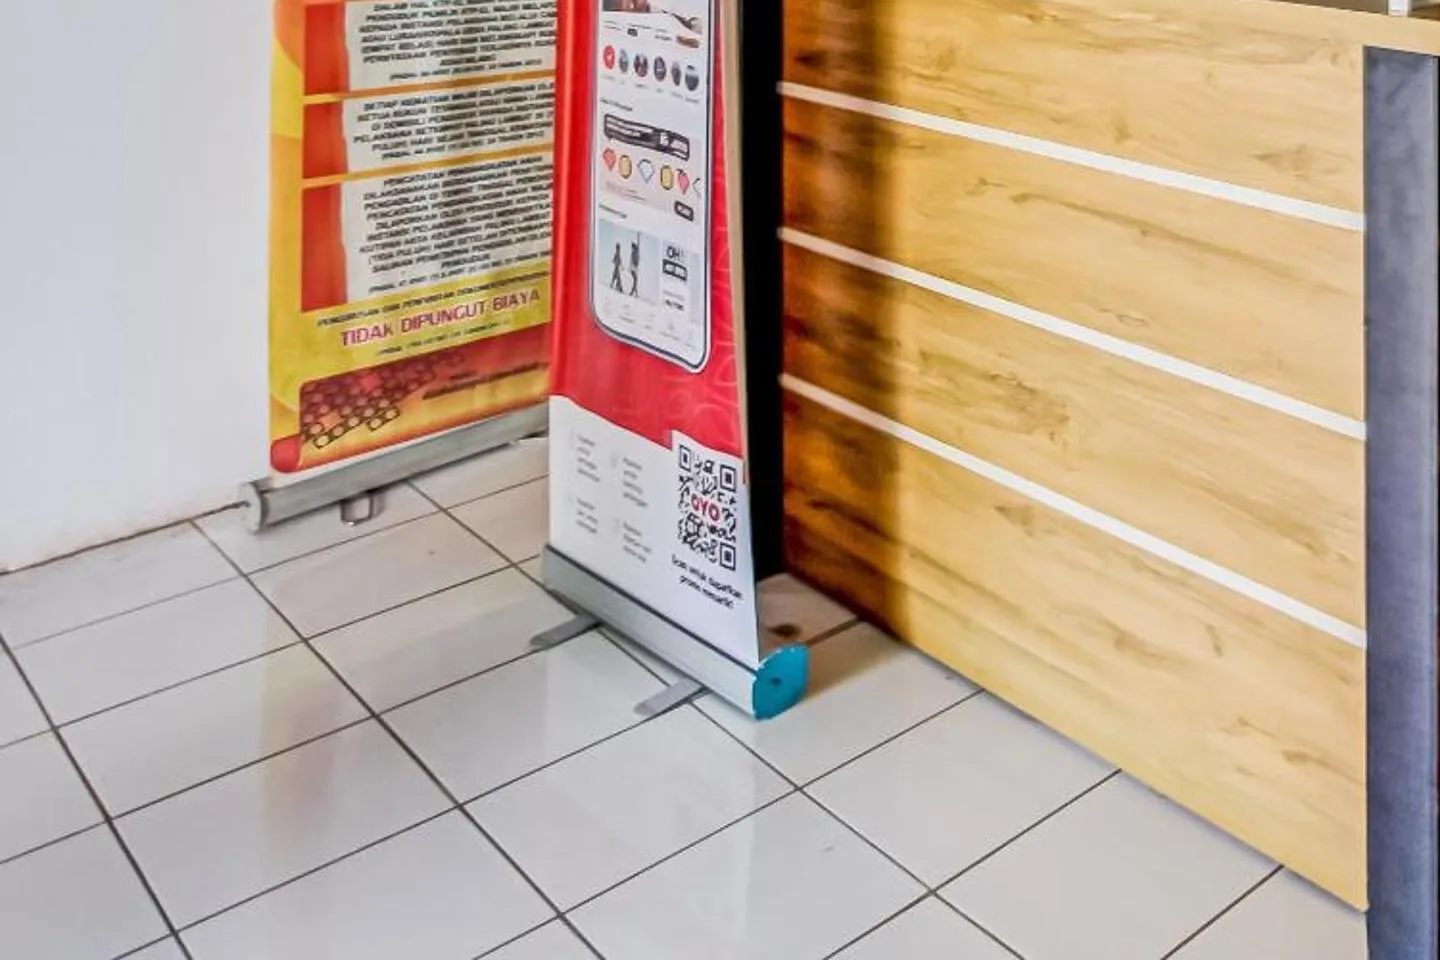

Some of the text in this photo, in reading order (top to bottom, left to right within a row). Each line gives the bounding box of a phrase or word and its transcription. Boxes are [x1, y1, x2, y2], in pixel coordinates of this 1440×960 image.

[340, 323, 394, 346] TIDAK
[400, 301, 487, 333] DIPUNGUT
[492, 289, 541, 311] BIAYA
[691, 495, 720, 522] OYO
